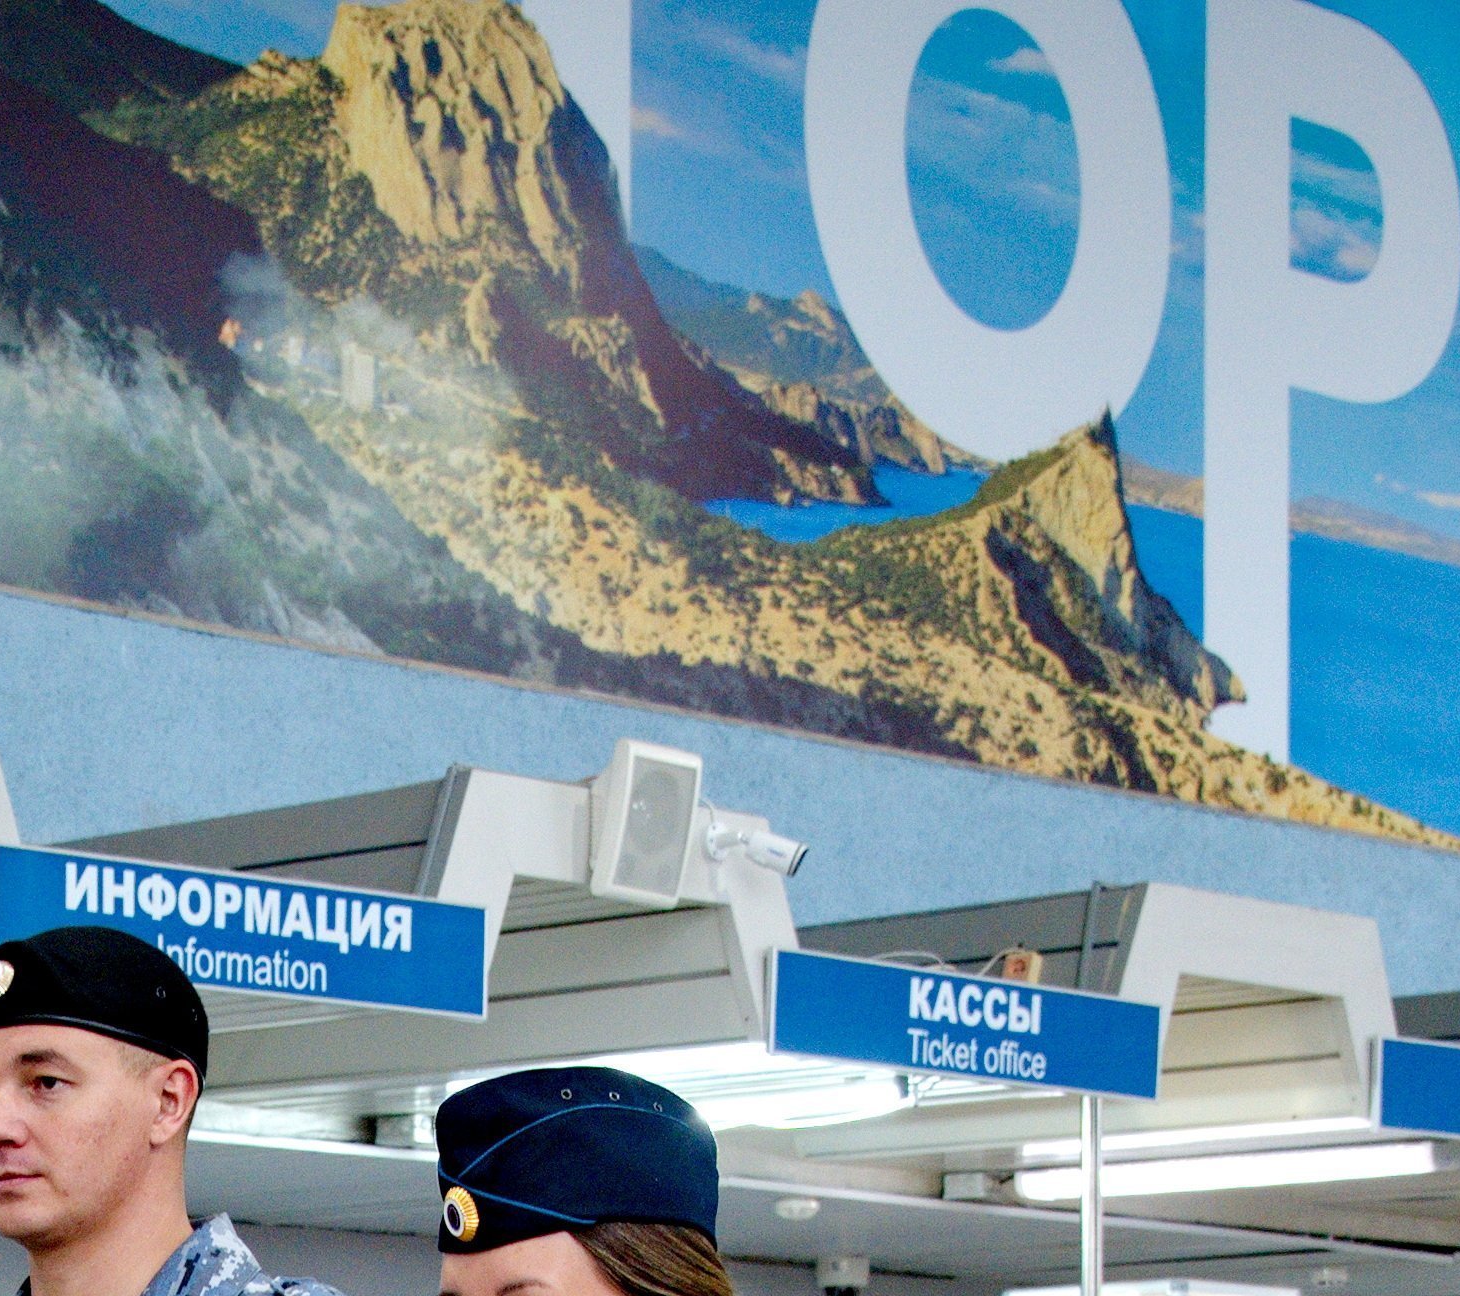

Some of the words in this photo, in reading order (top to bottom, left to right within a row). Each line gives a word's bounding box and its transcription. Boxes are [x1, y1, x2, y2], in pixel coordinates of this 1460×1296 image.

[64, 861, 414, 955] ИНФОРМАЦИЯ
[909, 975, 1042, 1036] КАССЫ
[907, 1026, 979, 1073] Ticket
[983, 1038, 1048, 1082] office
